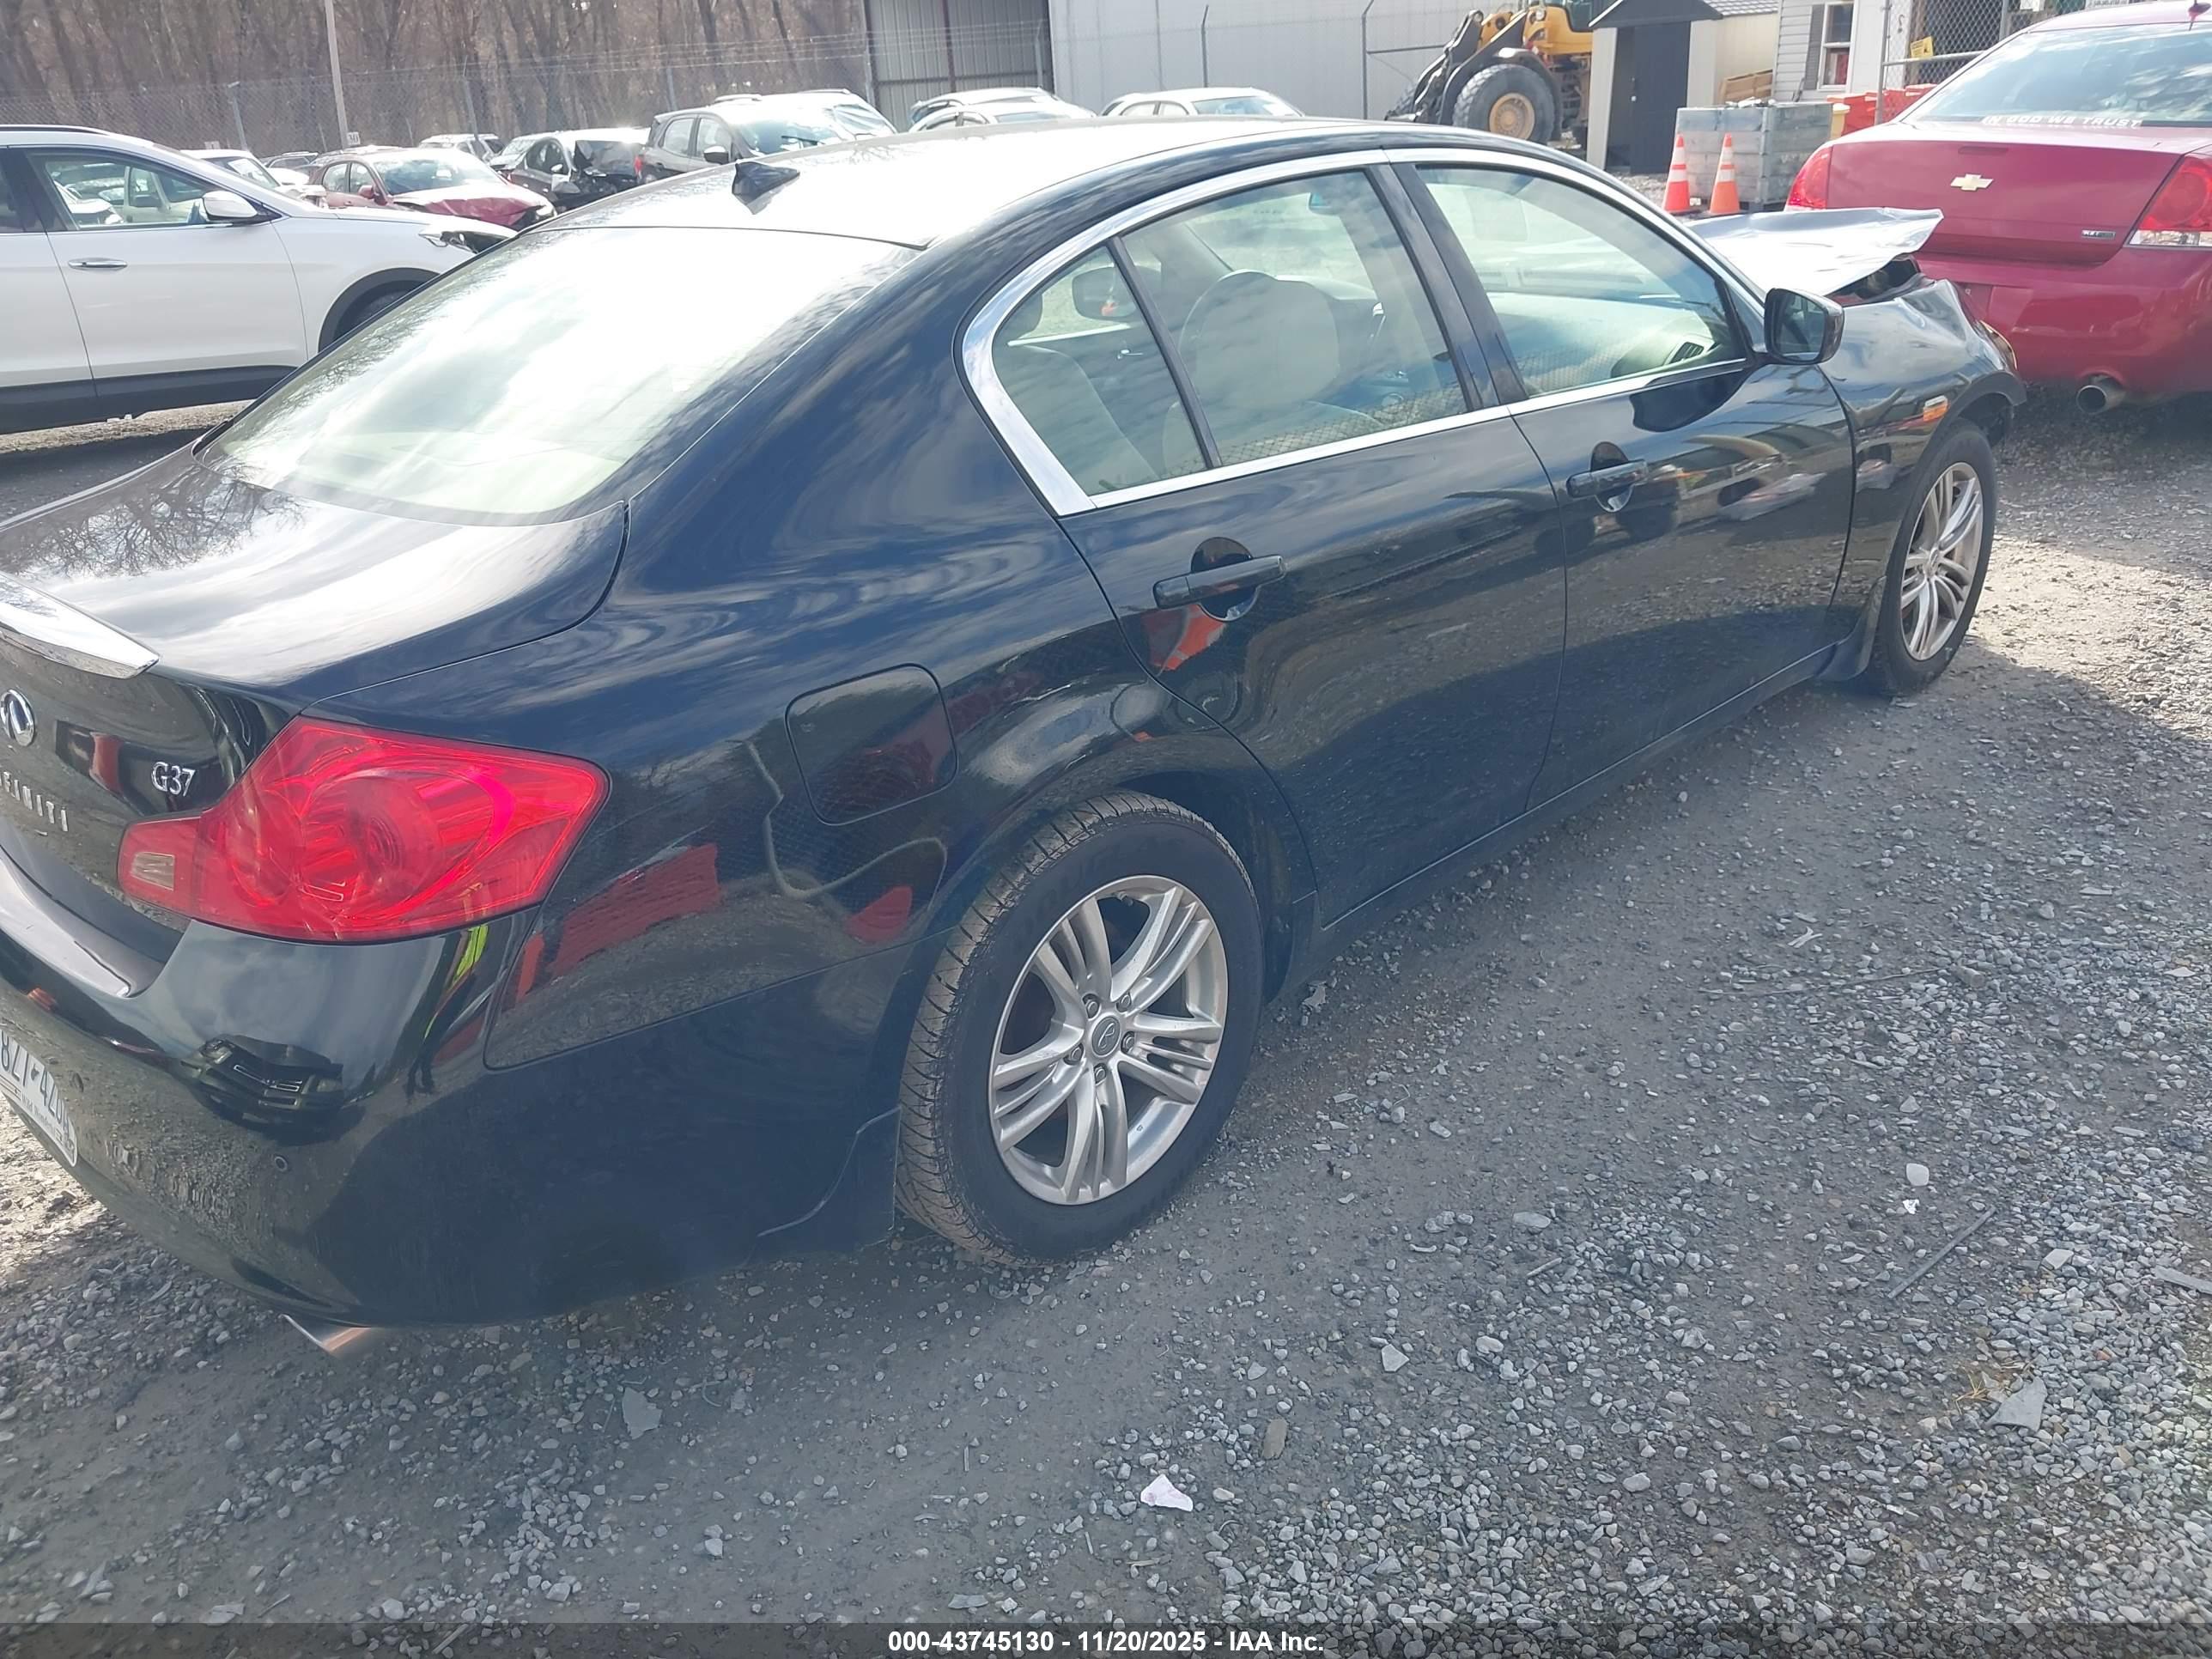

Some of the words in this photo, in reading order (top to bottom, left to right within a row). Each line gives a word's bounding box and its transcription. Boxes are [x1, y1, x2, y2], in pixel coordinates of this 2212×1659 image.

[1981, 115, 2000, 125] IN
[2082, 117, 2143, 128] TRUST
[151, 761, 197, 797] G37
